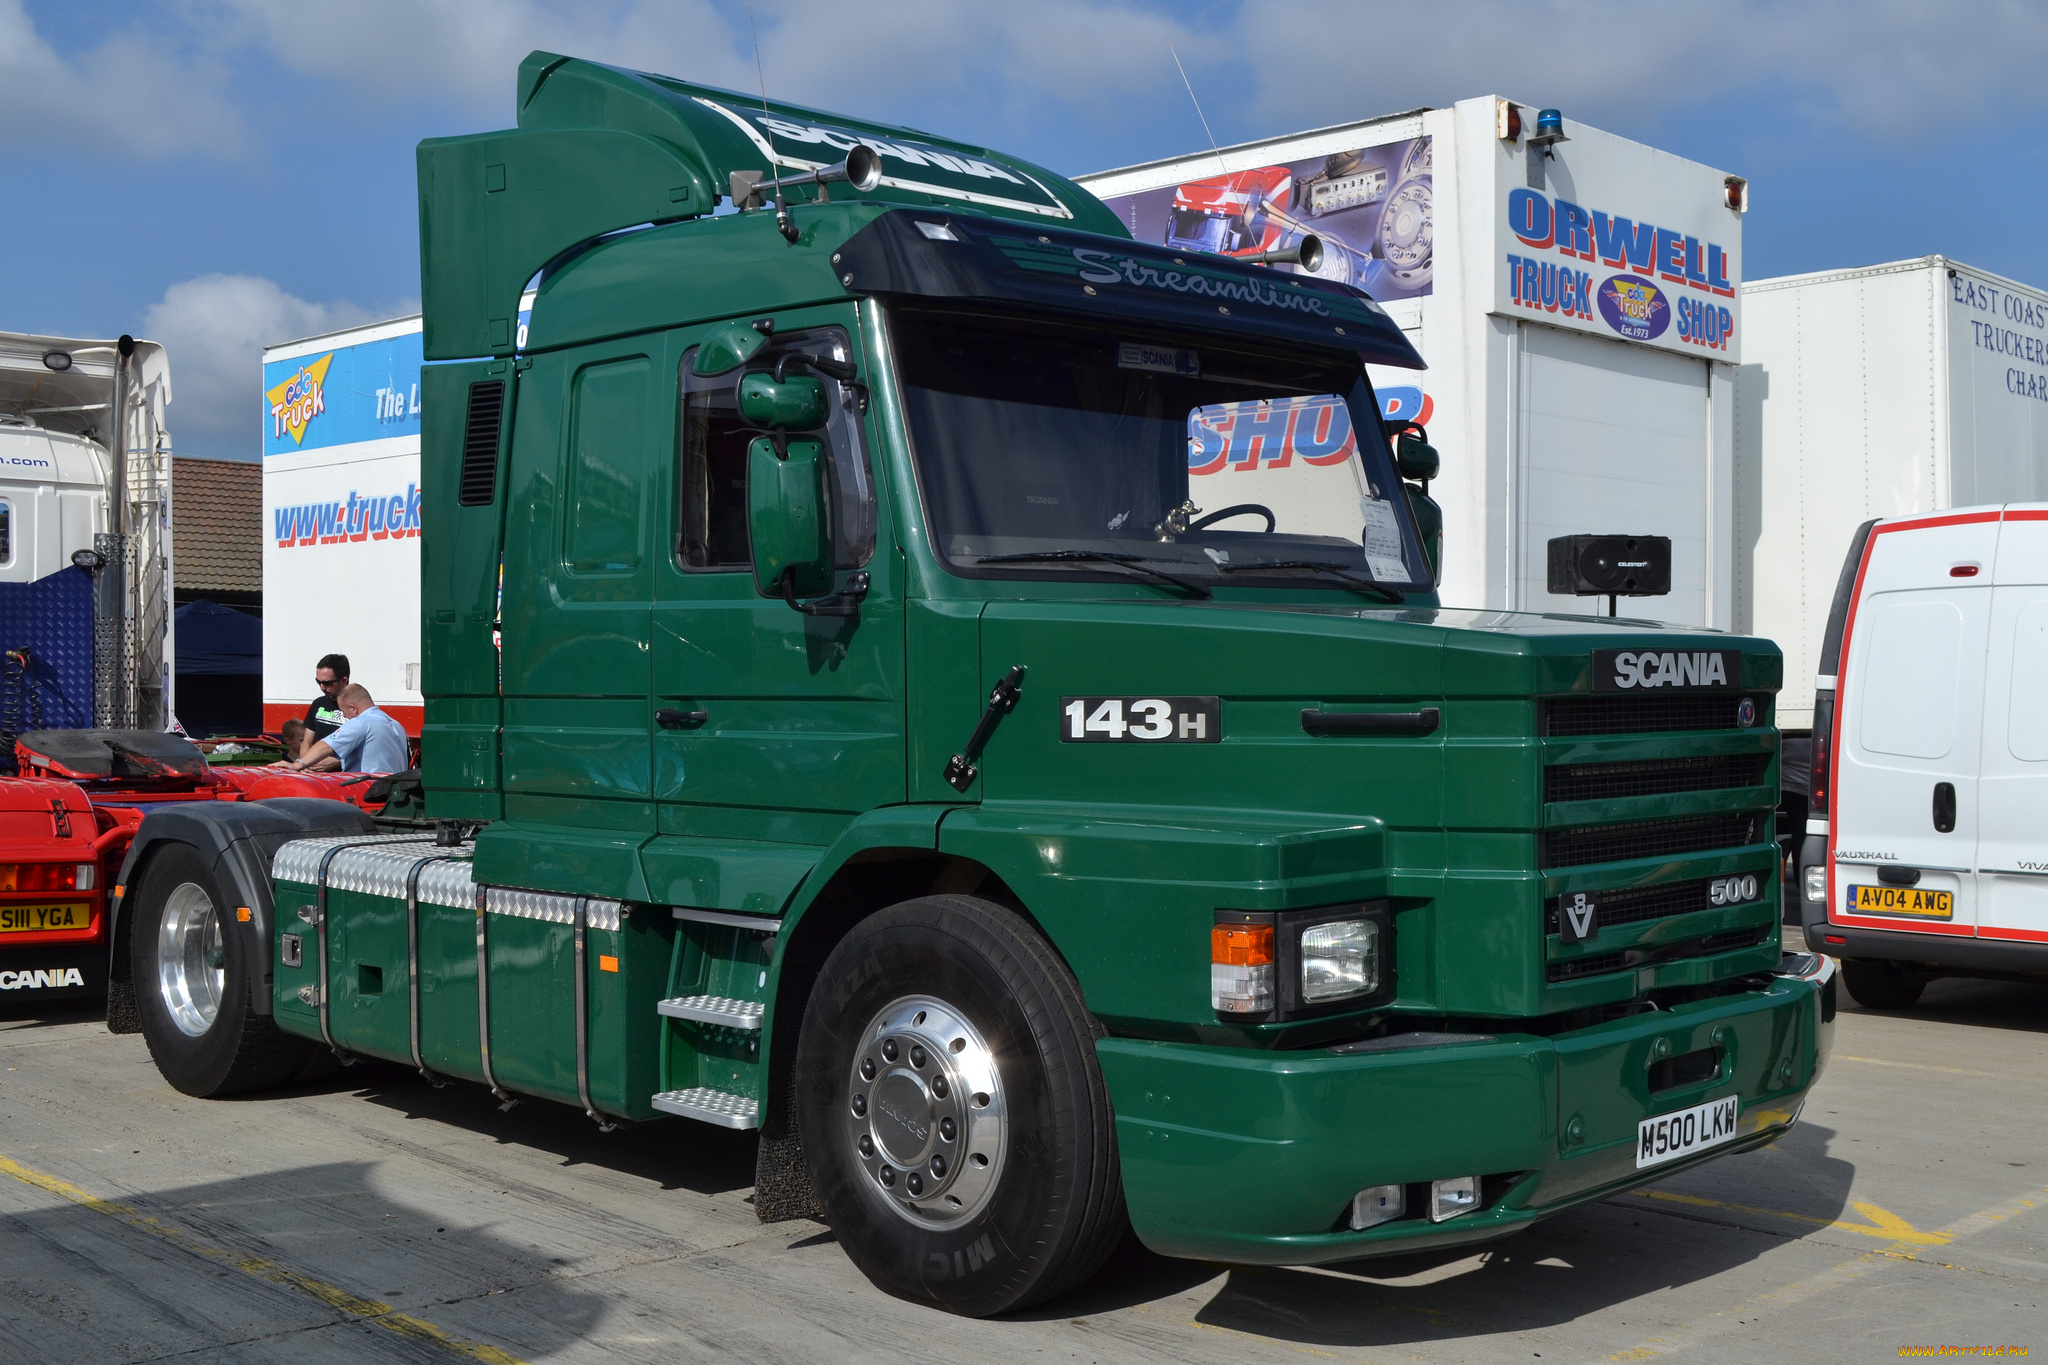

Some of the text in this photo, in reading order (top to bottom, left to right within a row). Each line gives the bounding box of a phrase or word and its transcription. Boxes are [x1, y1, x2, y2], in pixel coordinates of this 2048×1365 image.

[755, 116, 1026, 186] SCANIA
[1508, 187, 1734, 298] ORWELL
[1072, 248, 1330, 317] Streamline
[1953, 277, 1999, 314] EAST
[1507, 253, 1733, 351] TRUCK SHOP
[1618, 292, 1652, 320] Truck
[1142, 350, 1174, 367] SCANIA
[1971, 320, 2048, 366] TRUCKER
[285, 366, 312, 407] cdc
[376, 383, 421, 419] The L
[2006, 368, 2048, 402] CHAR
[271, 381, 325, 438] Truck
[274, 483, 421, 546] www.truck
[1614, 652, 1727, 688] SCANIA
[1065, 700, 1206, 739] 143 H
[1833, 850, 1899, 860] VAUXHALL
[1710, 875, 1757, 905] 500
[1860, 888, 1948, 911] AV04 AWG
[36, 907, 74, 926] YGA
[1641, 1100, 1736, 1159] M500 LKW
